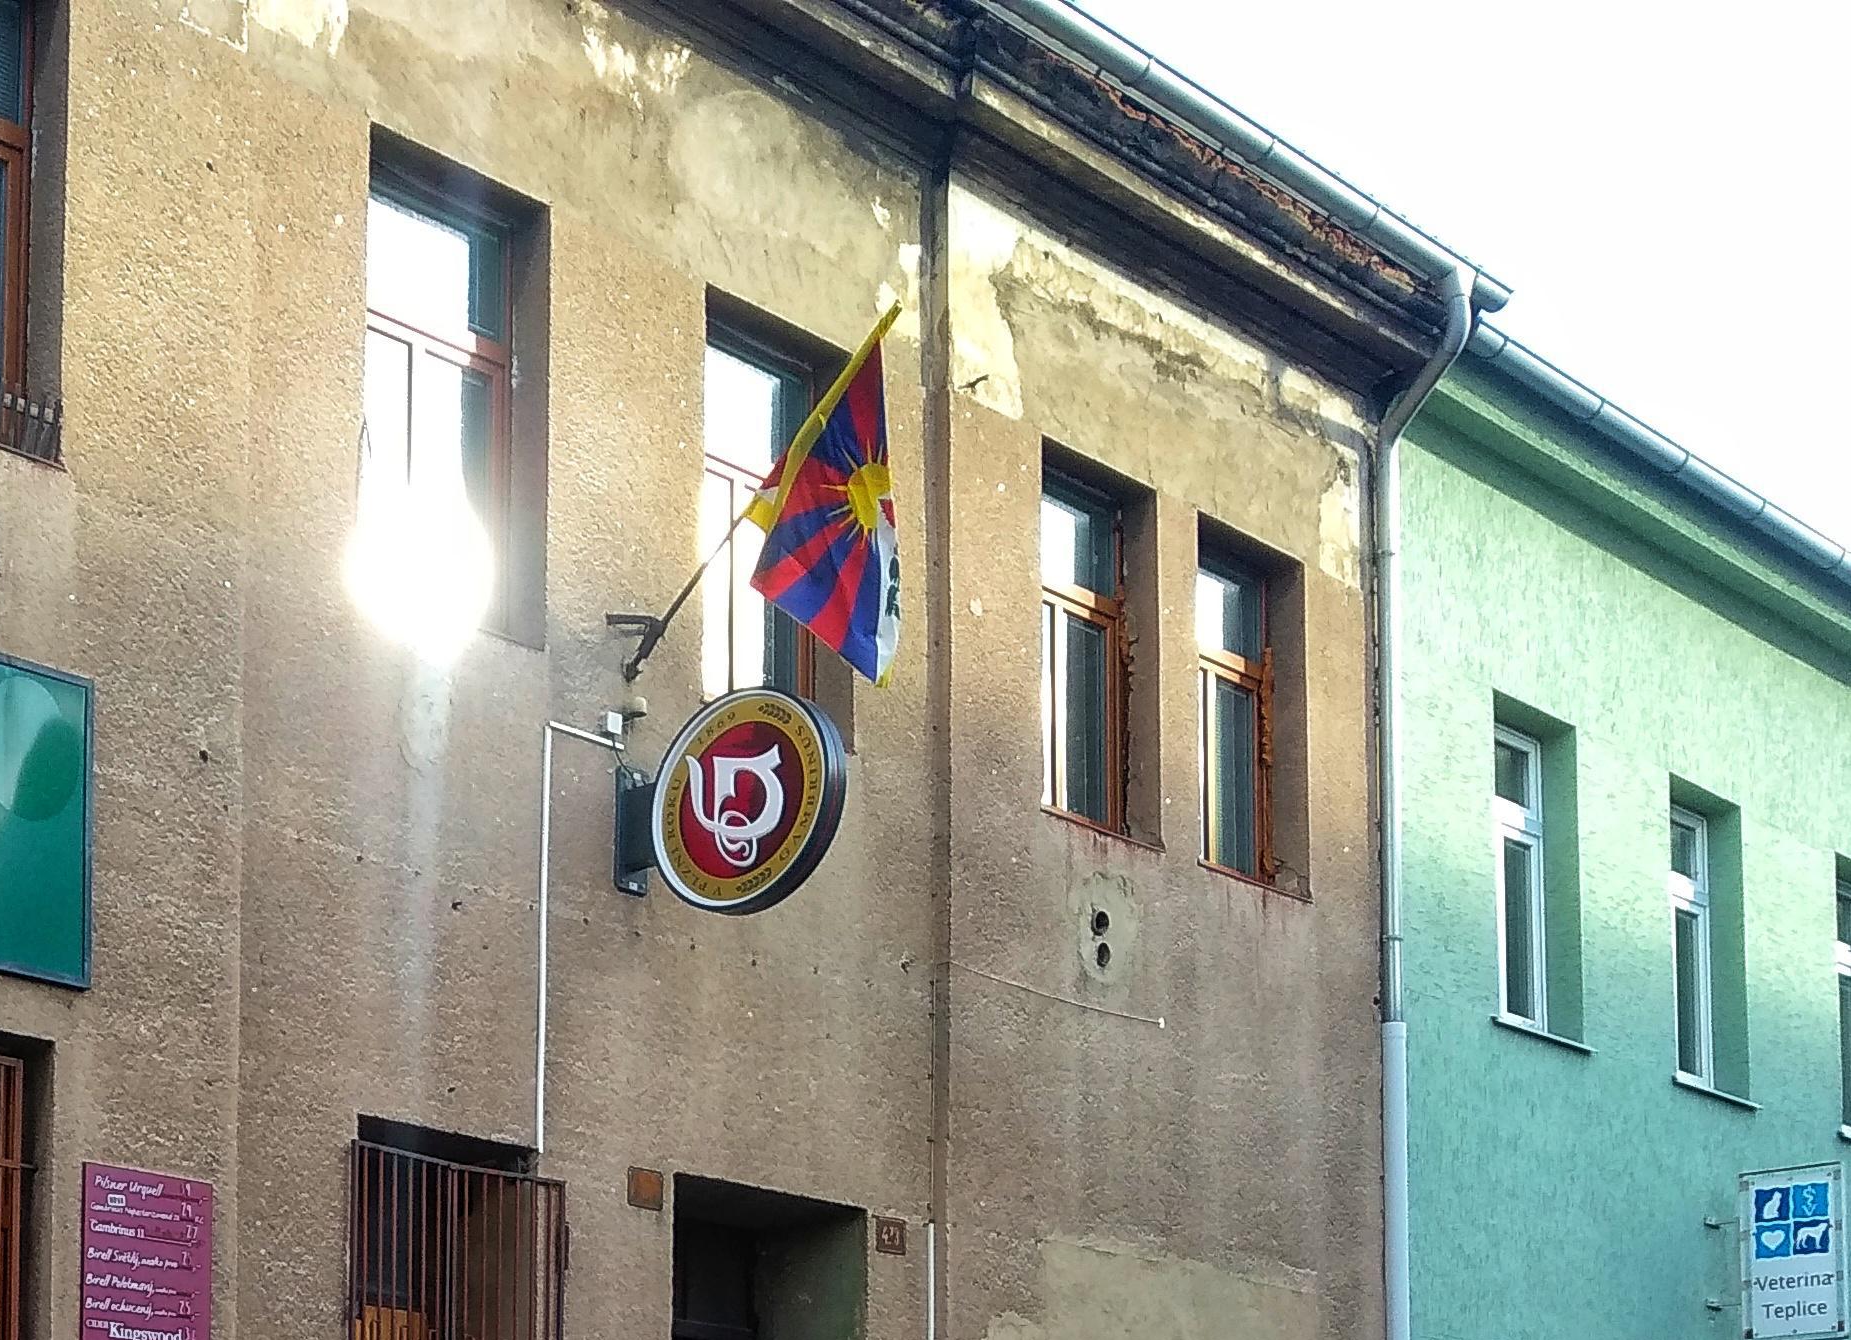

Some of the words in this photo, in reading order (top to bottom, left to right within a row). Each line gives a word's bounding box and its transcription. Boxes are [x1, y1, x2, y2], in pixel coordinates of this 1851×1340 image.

[778, 726, 819, 862] GAMBRINUS
[94, 1175, 128, 1191] Pilsner
[129, 1182, 164, 1200] Urquell
[90, 1218, 136, 1238] Gambrinus
[87, 1247, 113, 1261] Birell
[85, 1273, 111, 1286] Birell
[1756, 1273, 1834, 1292] Veterina
[84, 1297, 111, 1310] Birell
[1762, 1300, 1828, 1321] Teplice
